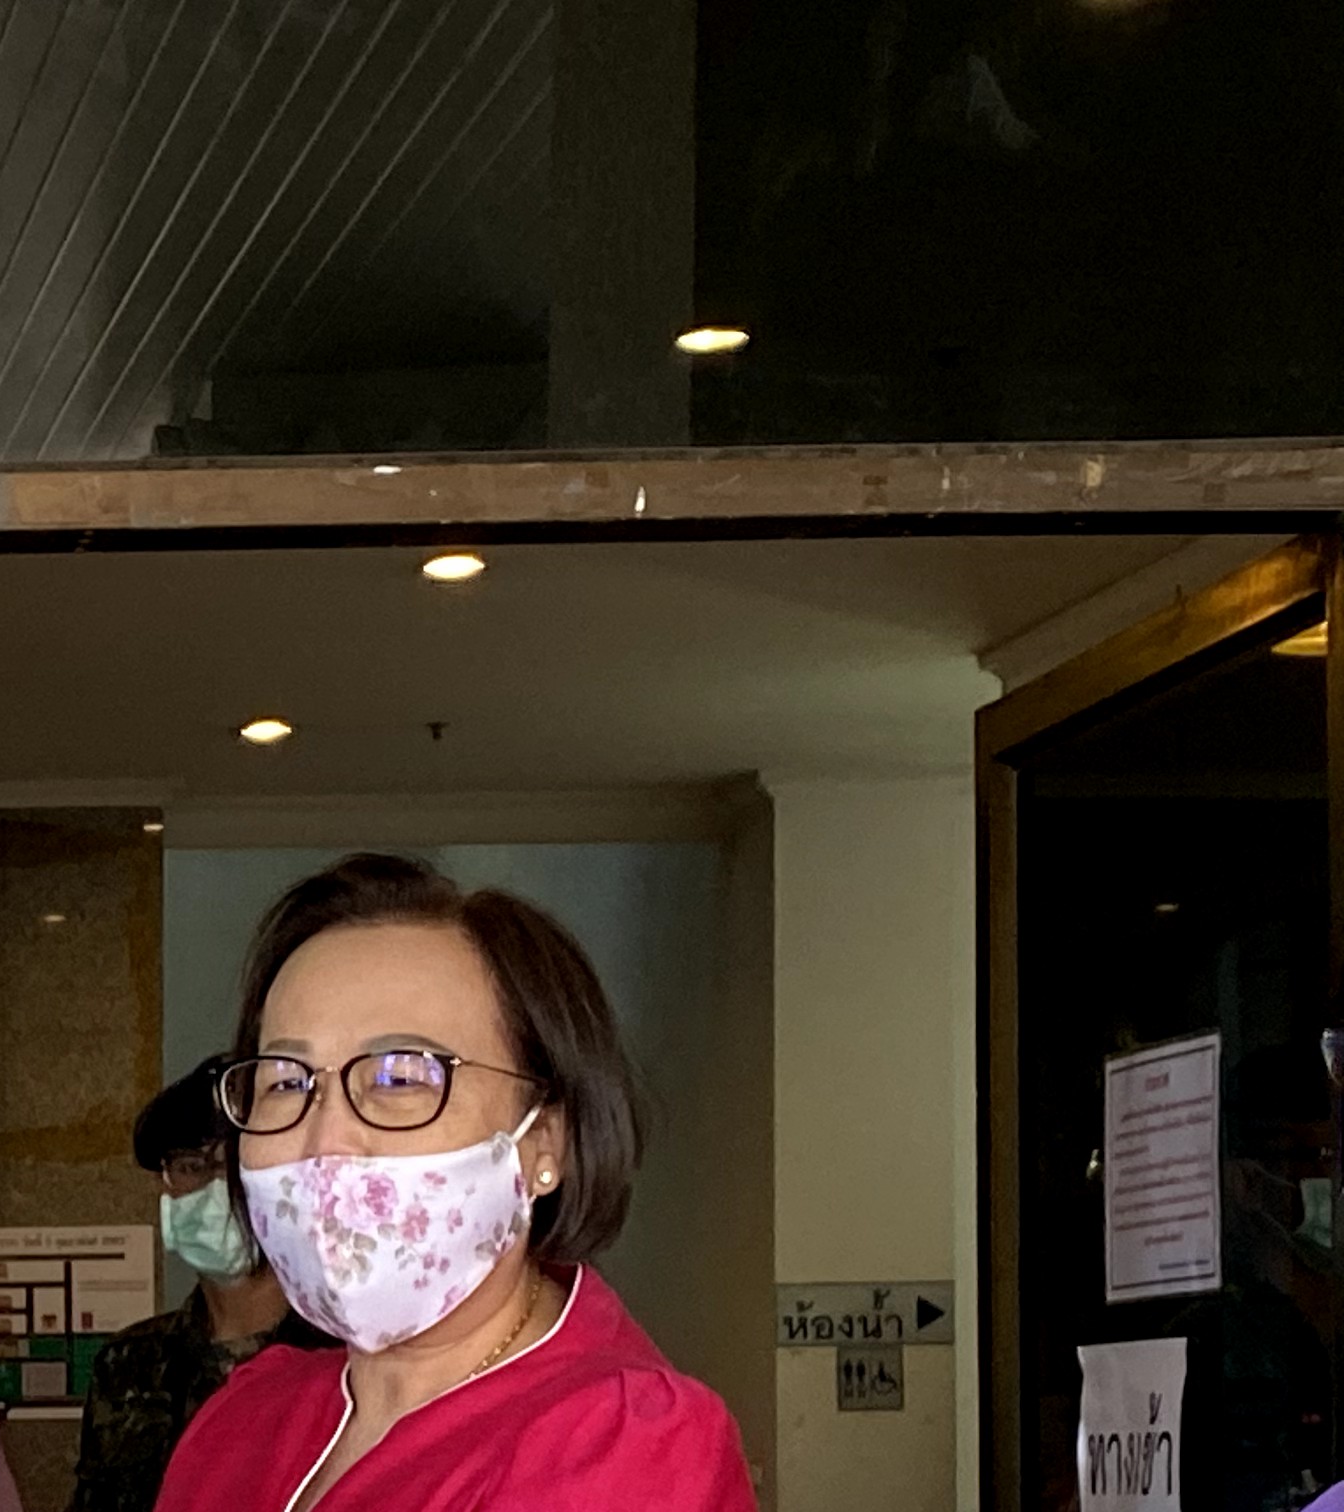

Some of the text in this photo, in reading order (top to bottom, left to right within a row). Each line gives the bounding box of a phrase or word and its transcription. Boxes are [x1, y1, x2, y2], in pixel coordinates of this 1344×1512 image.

[782, 1288, 904, 1341] ห้องน้ำ
[1088, 1392, 1173, 1496] ทางเข้า
